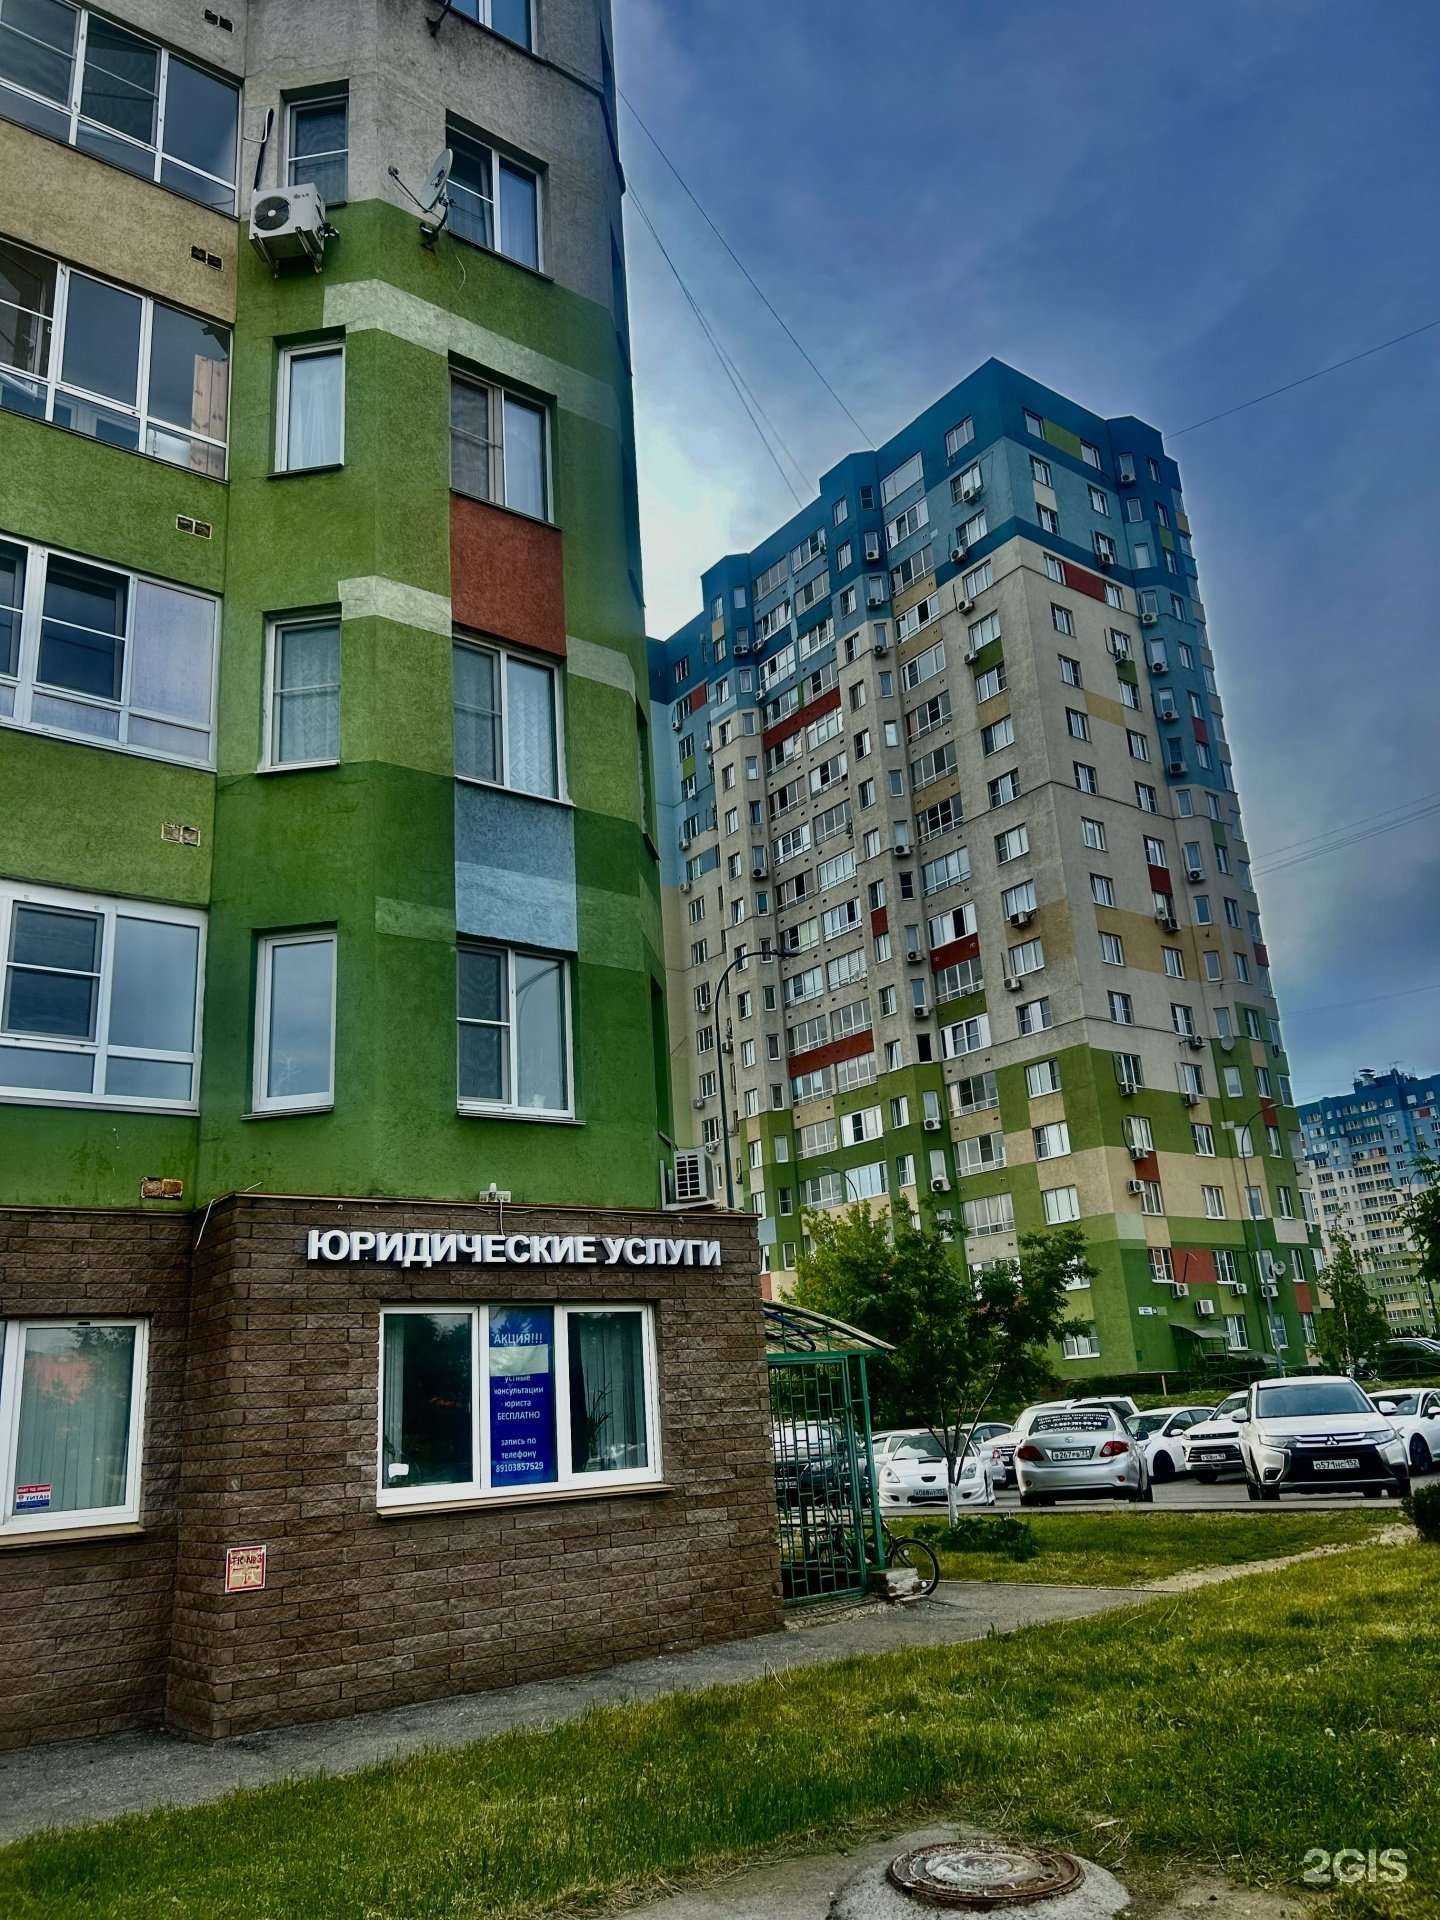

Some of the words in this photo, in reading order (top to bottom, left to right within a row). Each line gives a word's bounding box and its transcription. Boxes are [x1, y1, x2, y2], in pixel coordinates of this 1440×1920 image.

[307, 1229, 597, 1268] ЮРИДИЧЕСКИЕ
[600, 1237, 722, 1266] УСЛУГИ
[494, 1332, 543, 1346] АКЦИЯ!!!
[497, 1411, 541, 1421] БЕСПЛАТНО
[501, 1439, 525, 1447] запись
[526, 1437, 537, 1445] по
